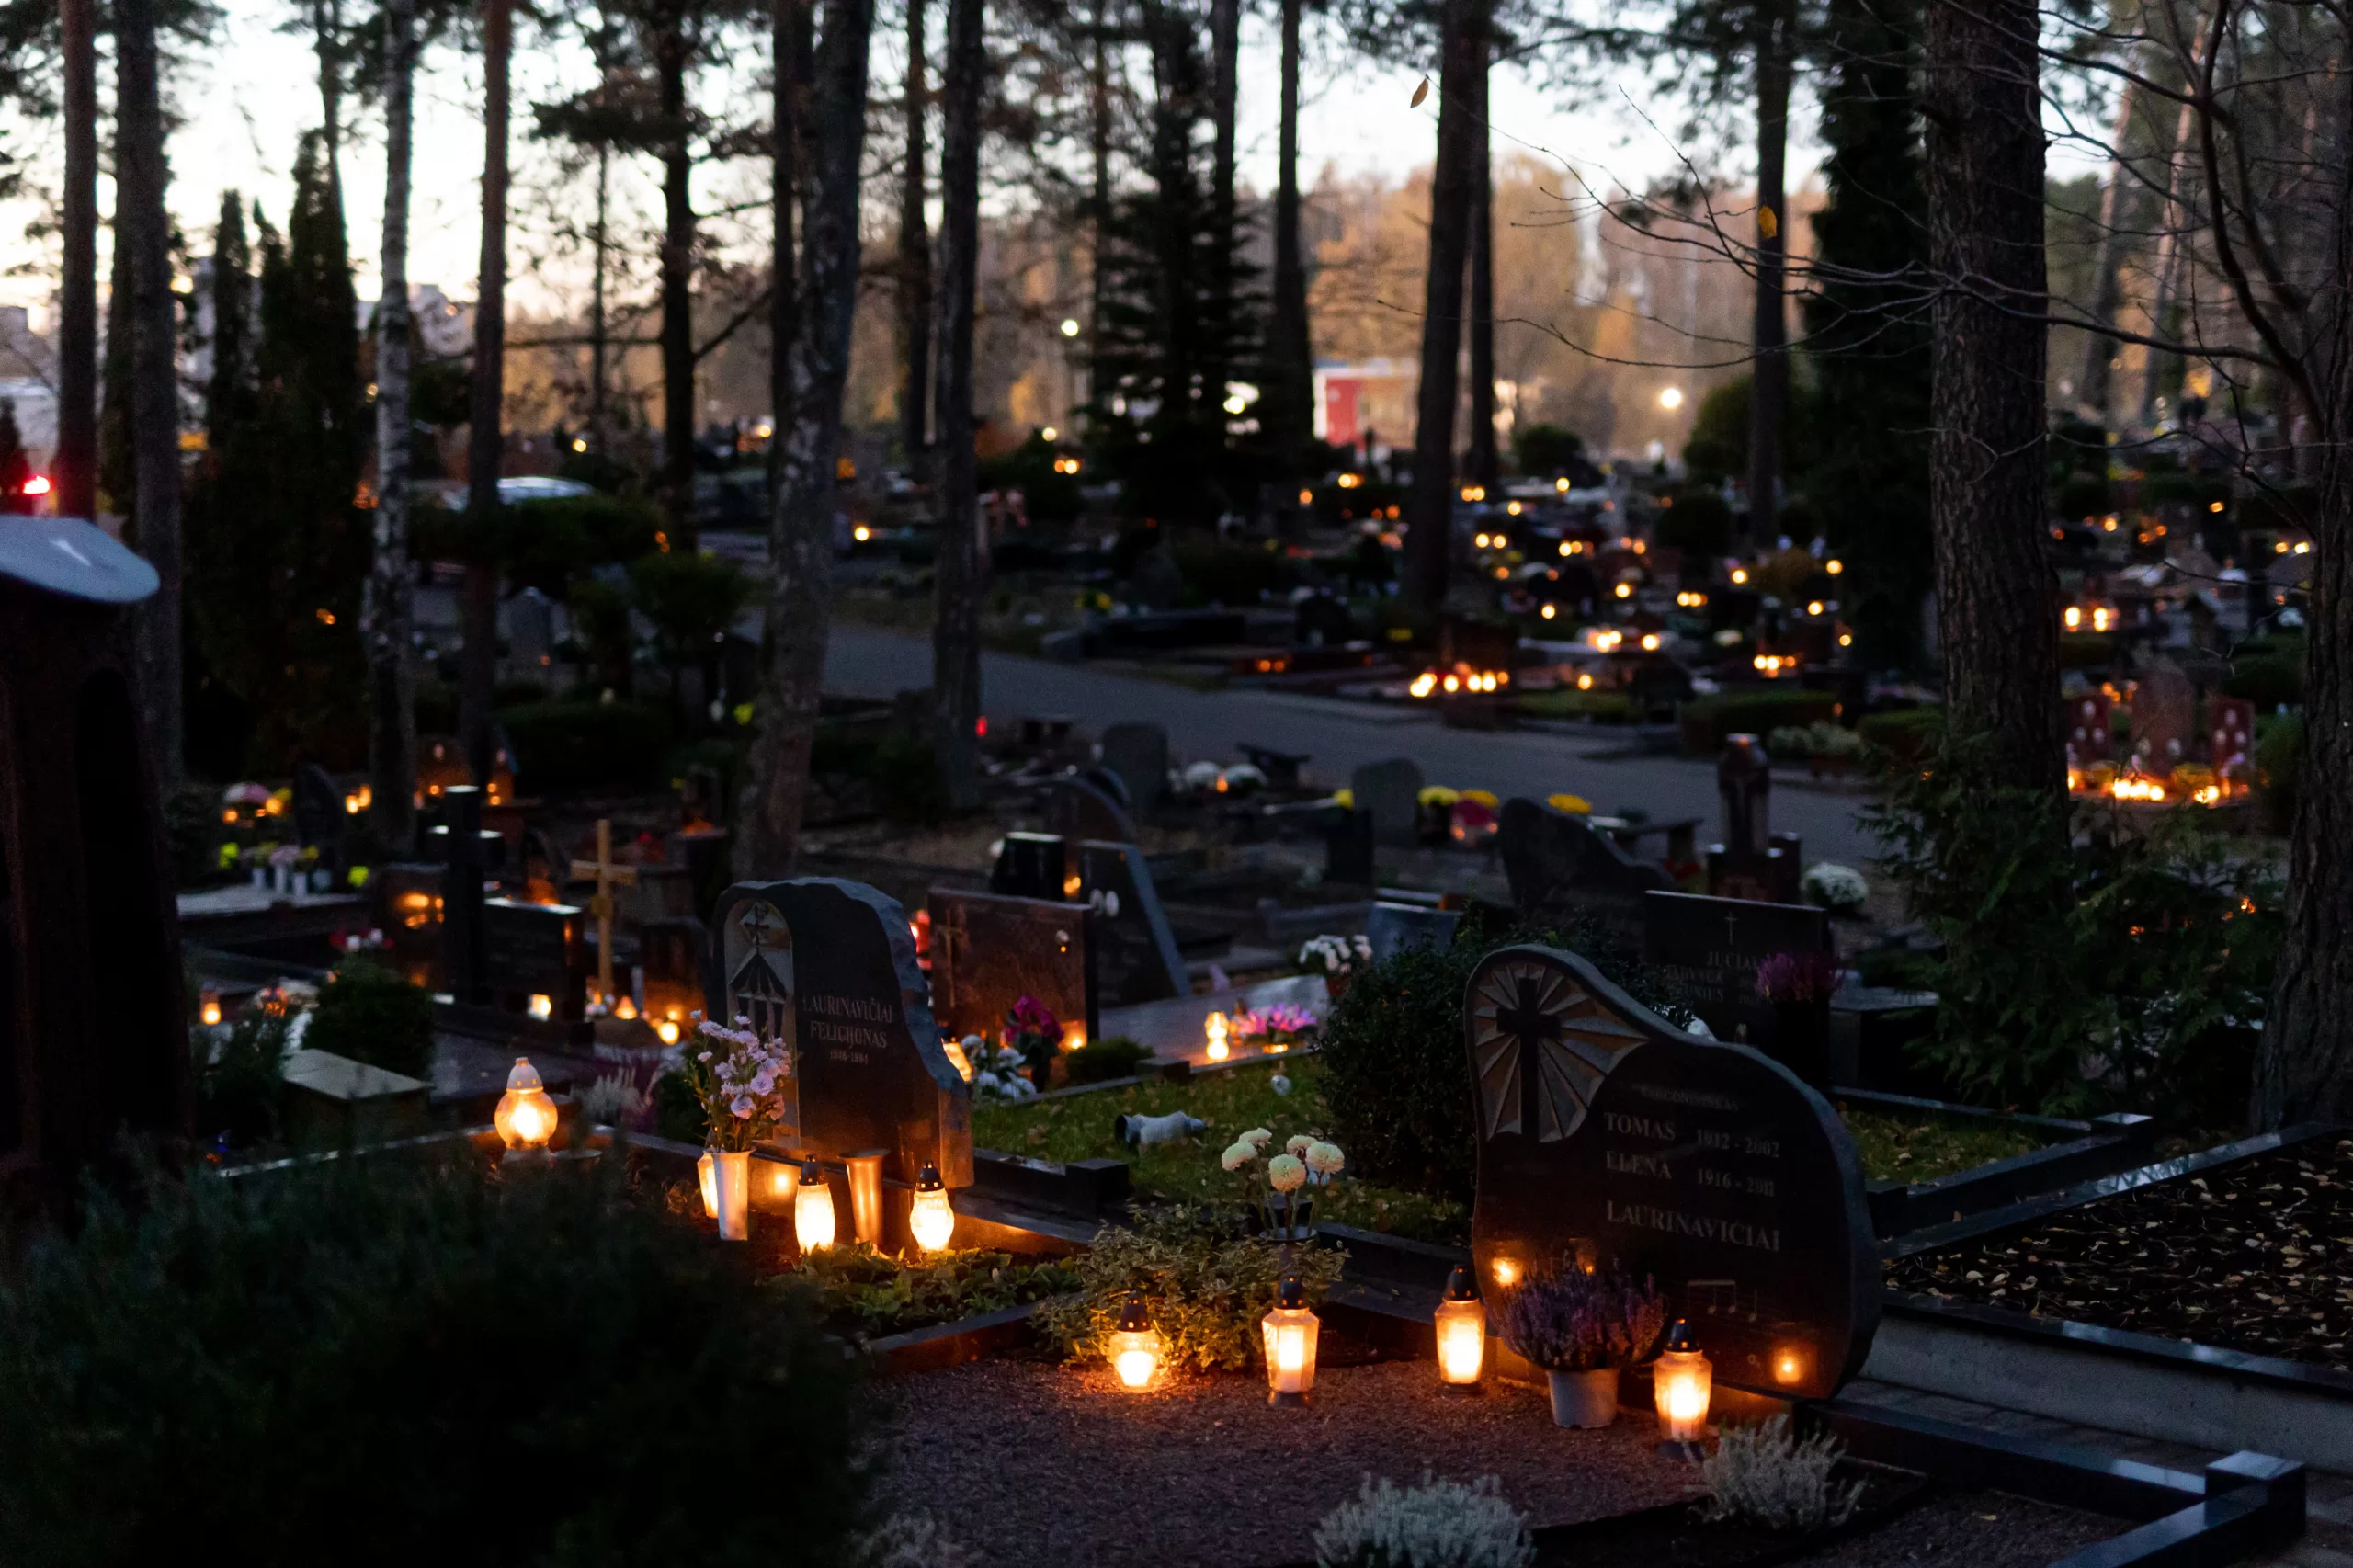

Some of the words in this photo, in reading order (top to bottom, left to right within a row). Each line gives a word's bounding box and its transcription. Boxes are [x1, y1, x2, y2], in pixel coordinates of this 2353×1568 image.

[1603, 1111, 1676, 1141] TOMAS
[1606, 1151, 1673, 1180] ELENA
[1698, 1168, 1732, 1189] 1916
